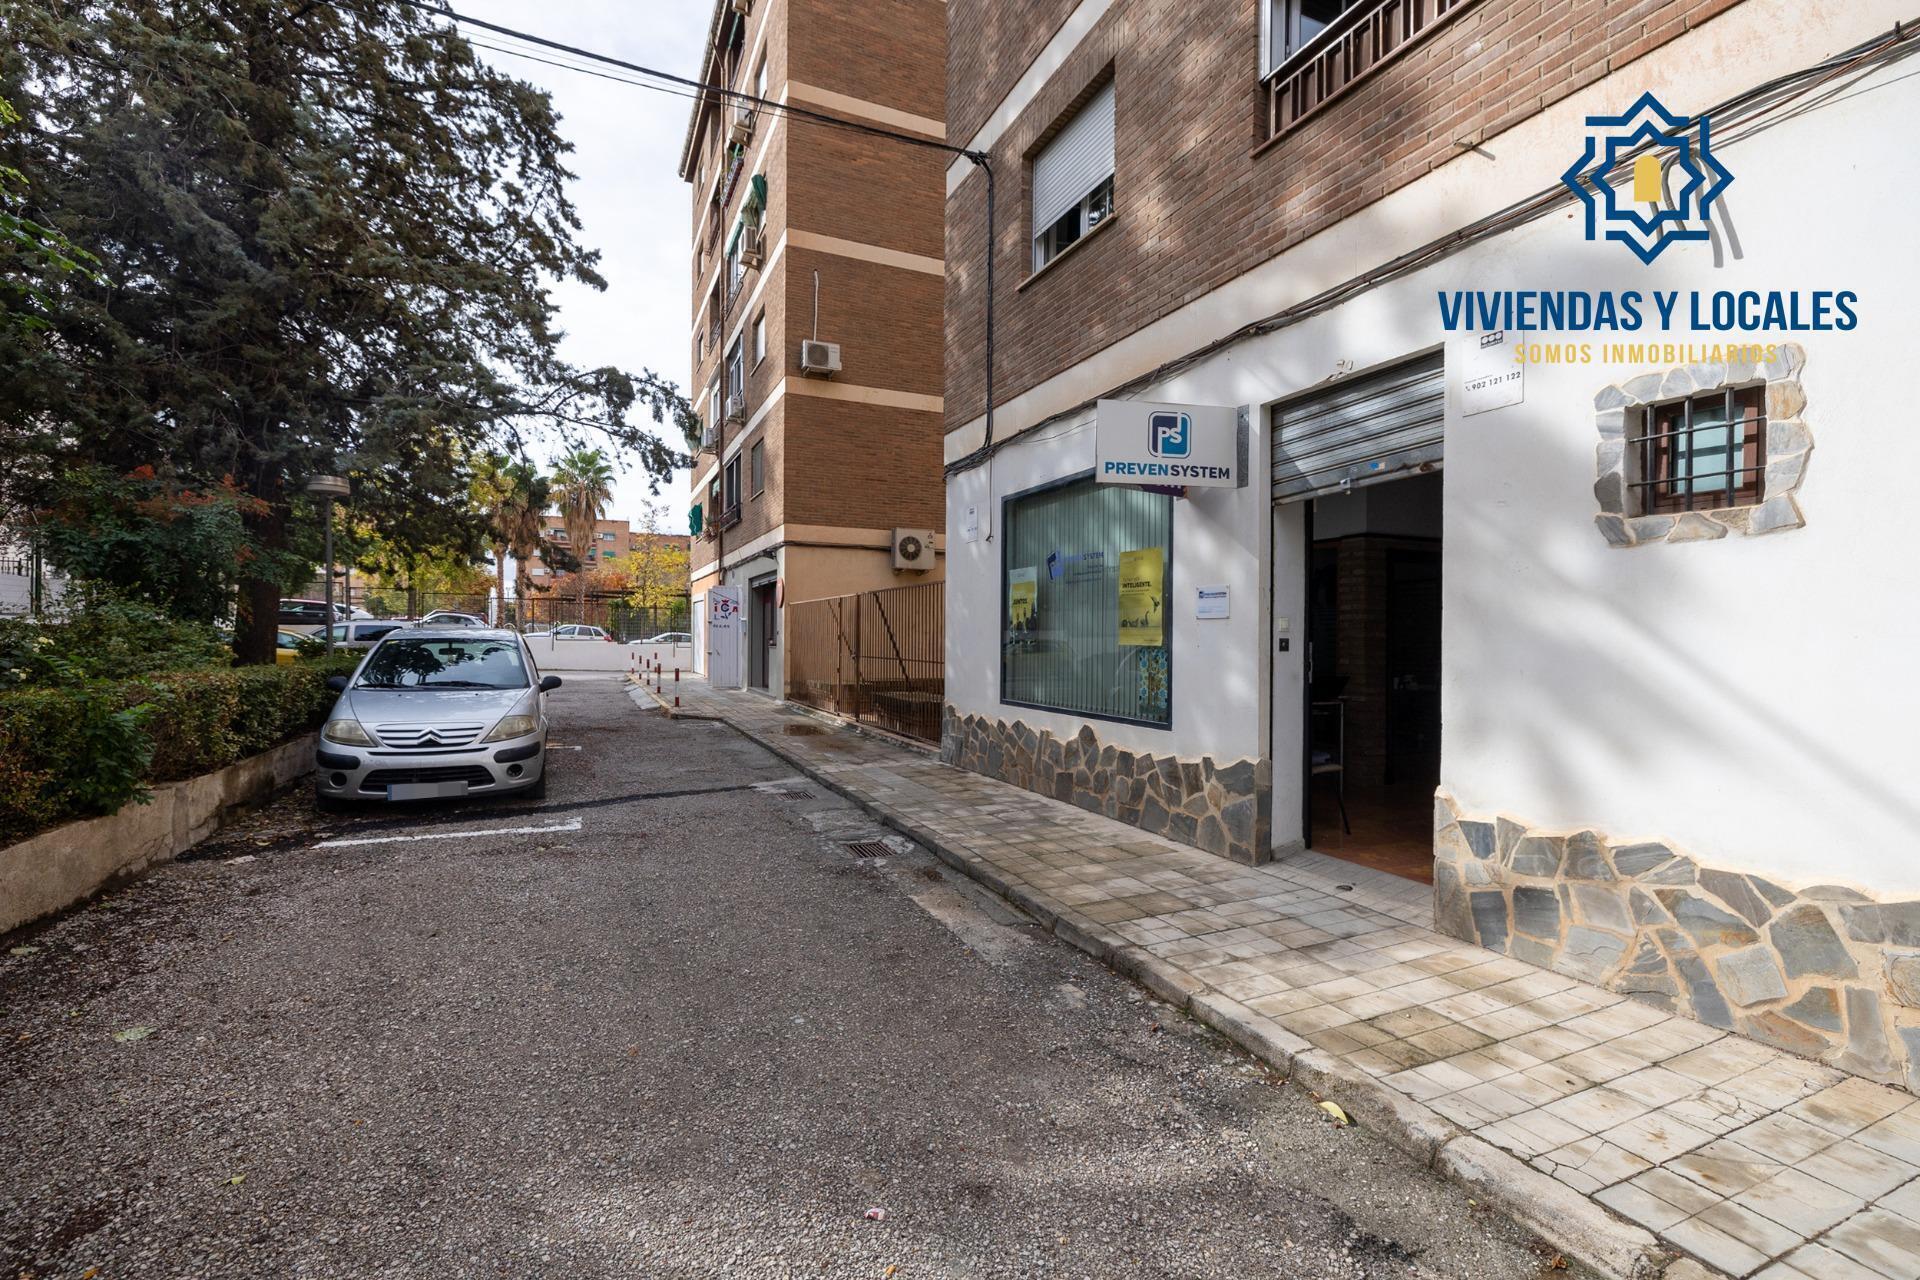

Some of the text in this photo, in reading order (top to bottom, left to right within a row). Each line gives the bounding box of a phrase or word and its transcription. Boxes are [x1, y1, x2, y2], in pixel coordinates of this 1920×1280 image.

[1472, 381, 1486, 390] 902
[1489, 376, 1502, 386] 121
[1506, 371, 1521, 381] 122
[1104, 461, 1230, 479] PREVENSYSTEM
